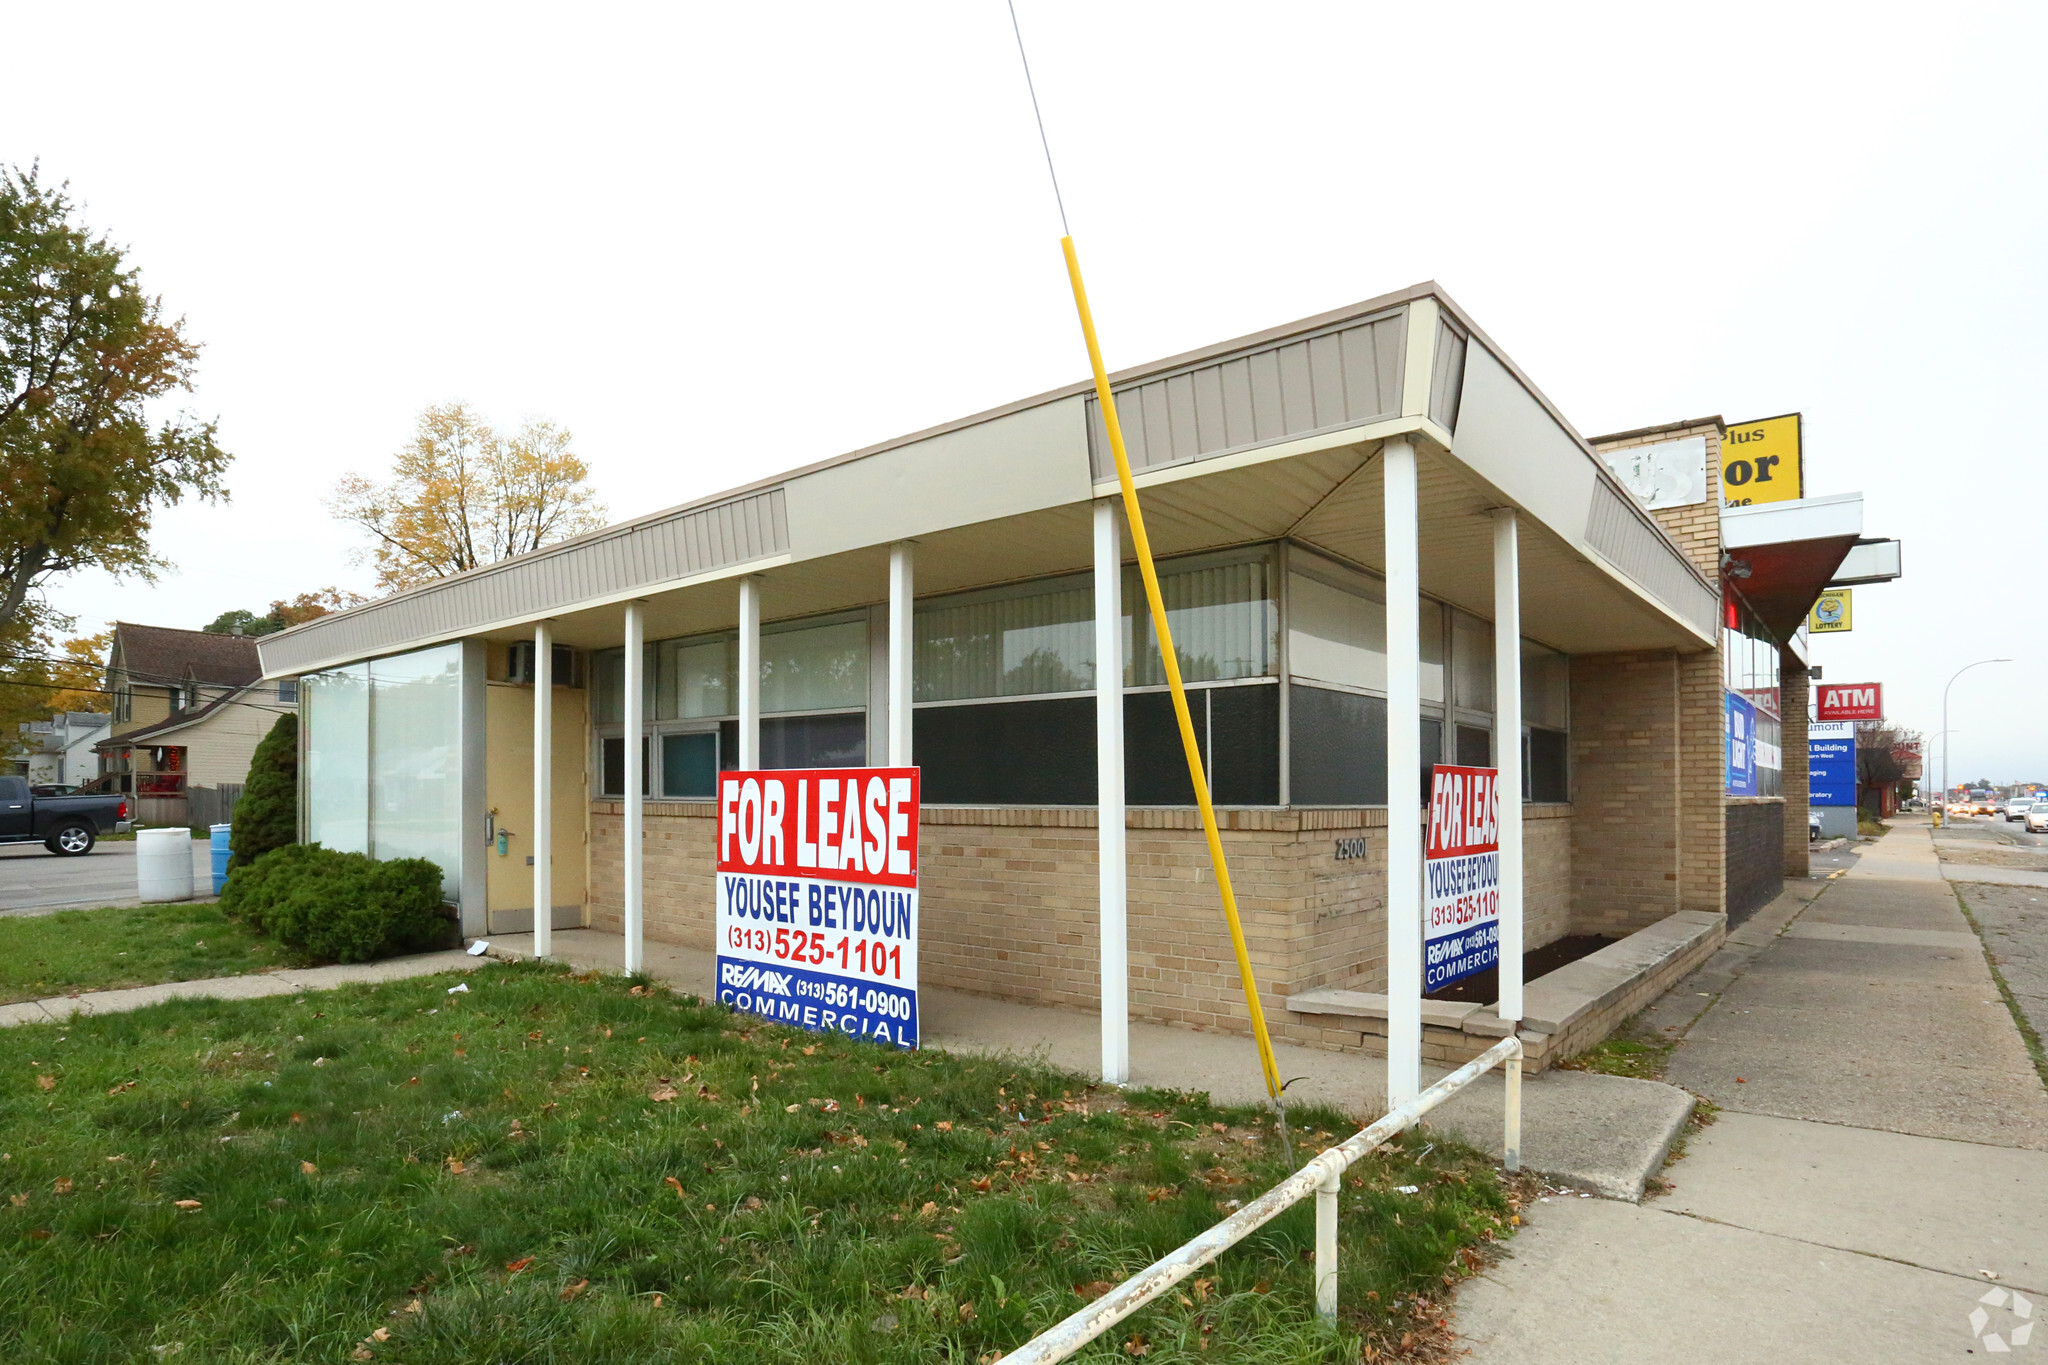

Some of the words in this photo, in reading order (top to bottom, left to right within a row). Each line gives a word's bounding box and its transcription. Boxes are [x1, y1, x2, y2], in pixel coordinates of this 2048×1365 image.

[1724, 453, 1780, 487] or
[1815, 621, 1843, 630] LOTTERY
[1823, 687, 1875, 708] ATM
[1814, 743, 1848, 753] Building
[721, 777, 785, 866] FOR
[797, 775, 912, 875] LEASE
[1429, 772, 1464, 851] FOR
[1335, 838, 1365, 860] 2500
[1428, 858, 1466, 900] YOUSEF
[724, 876, 800, 923] YOUSEF
[808, 883, 912, 940] BEYDOUN
[721, 962, 794, 997] RE/MAX
[720, 988, 911, 1047] COMMERCIAL
